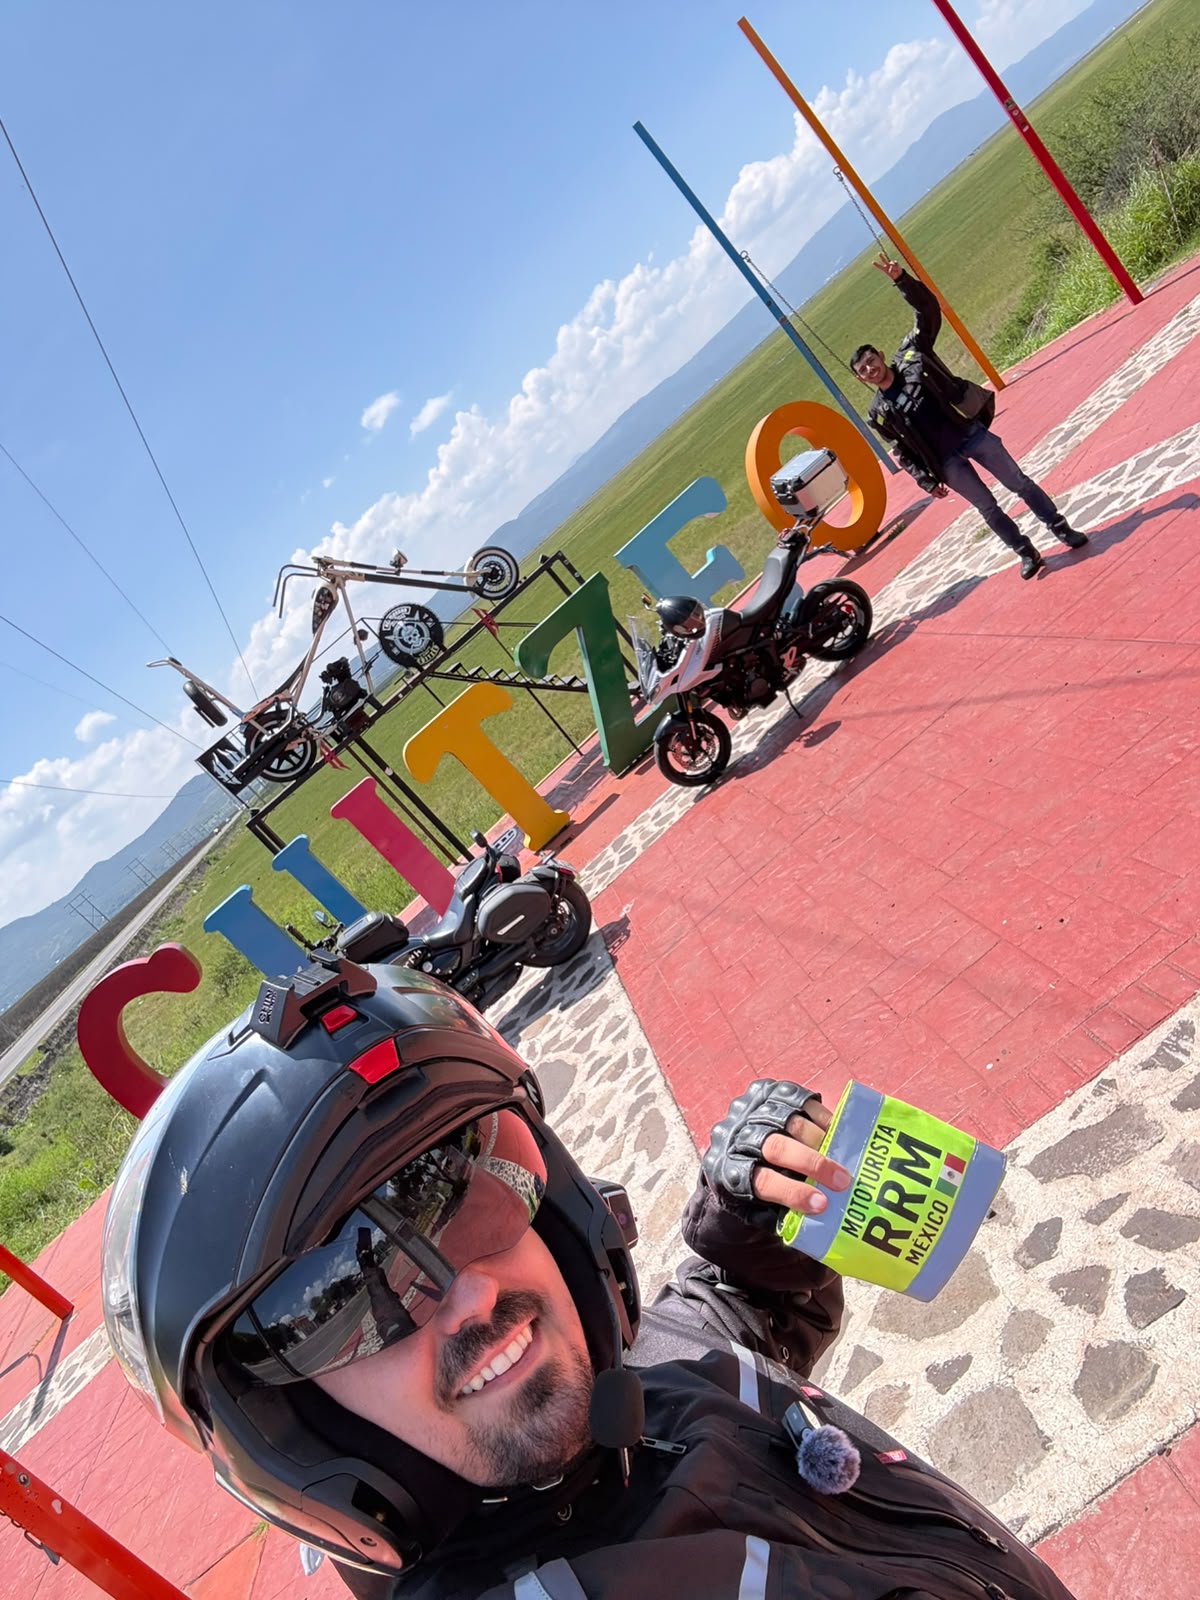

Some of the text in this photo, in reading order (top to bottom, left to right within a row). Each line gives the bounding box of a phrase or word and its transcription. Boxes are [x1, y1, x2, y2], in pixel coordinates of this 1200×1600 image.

[841, 1124, 897, 1239] MOTOTURISTA
[861, 1131, 943, 1258] RRM
[905, 1199, 949, 1266] MÉXICO
